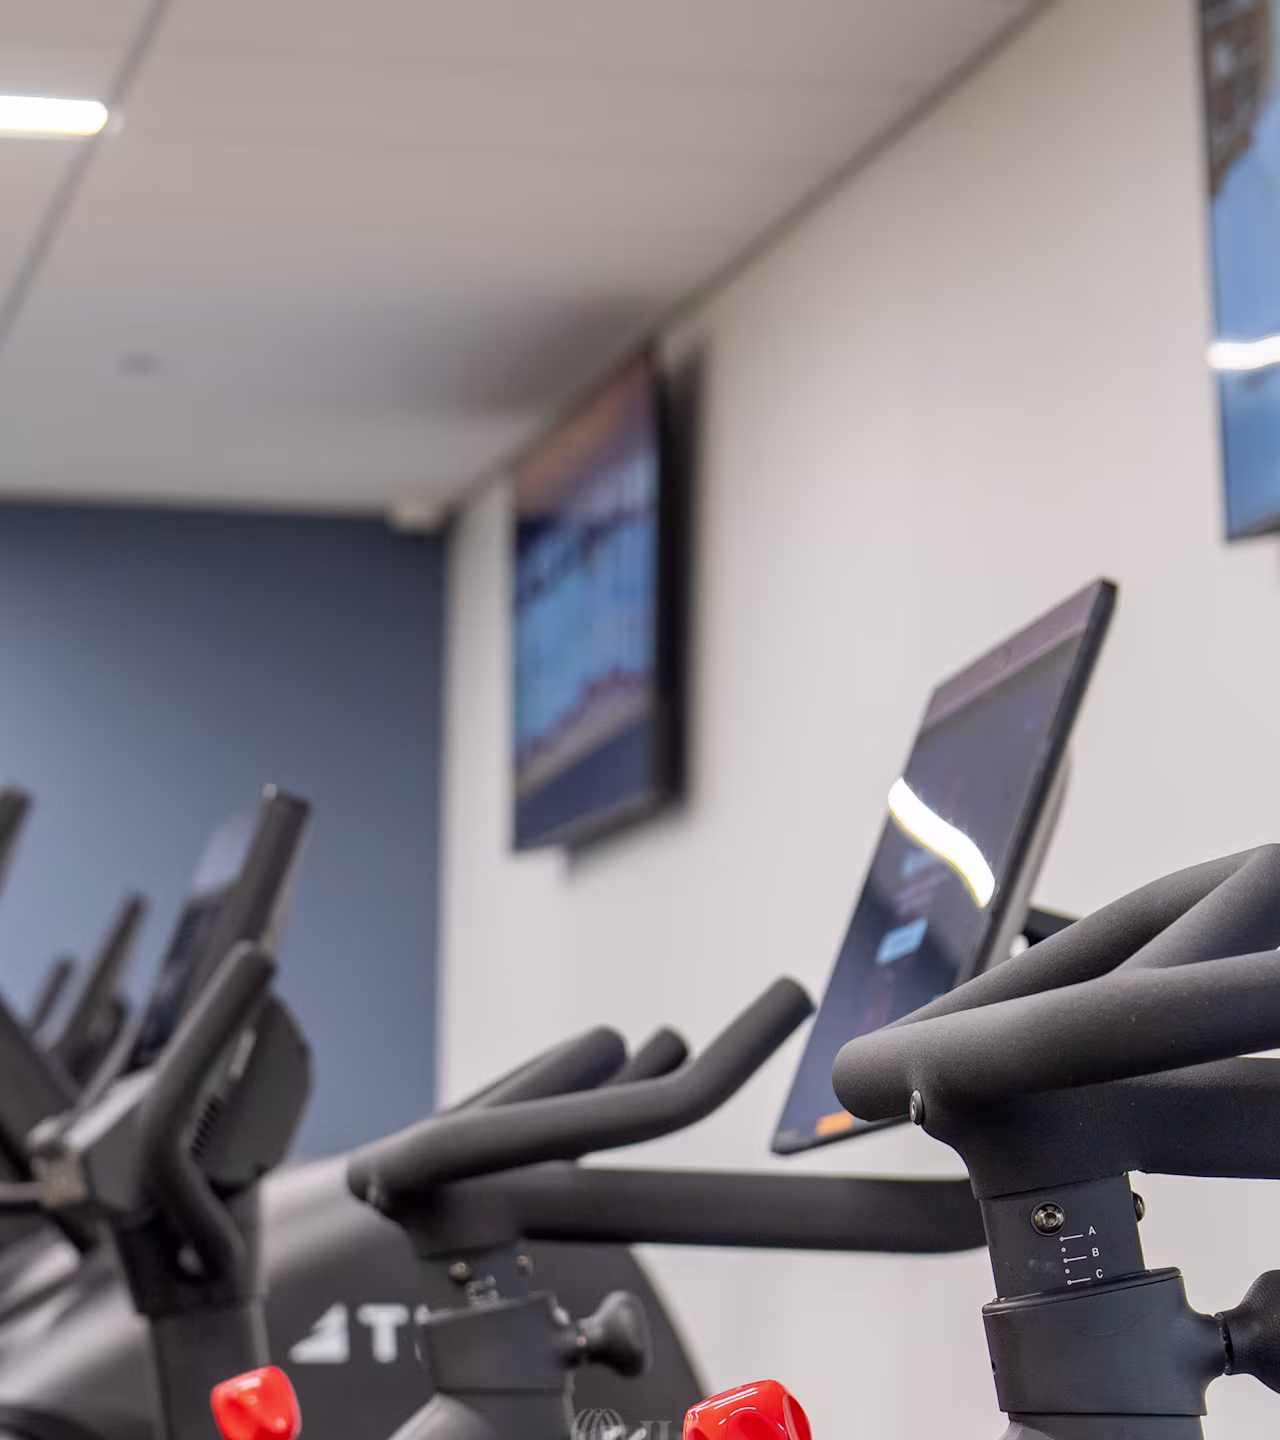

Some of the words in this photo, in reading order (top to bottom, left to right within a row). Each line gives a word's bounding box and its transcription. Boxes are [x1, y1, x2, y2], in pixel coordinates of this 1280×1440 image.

[1088, 1226, 1096, 1236] A
[1092, 1247, 1100, 1258] B
[1096, 1269, 1104, 1279] C
